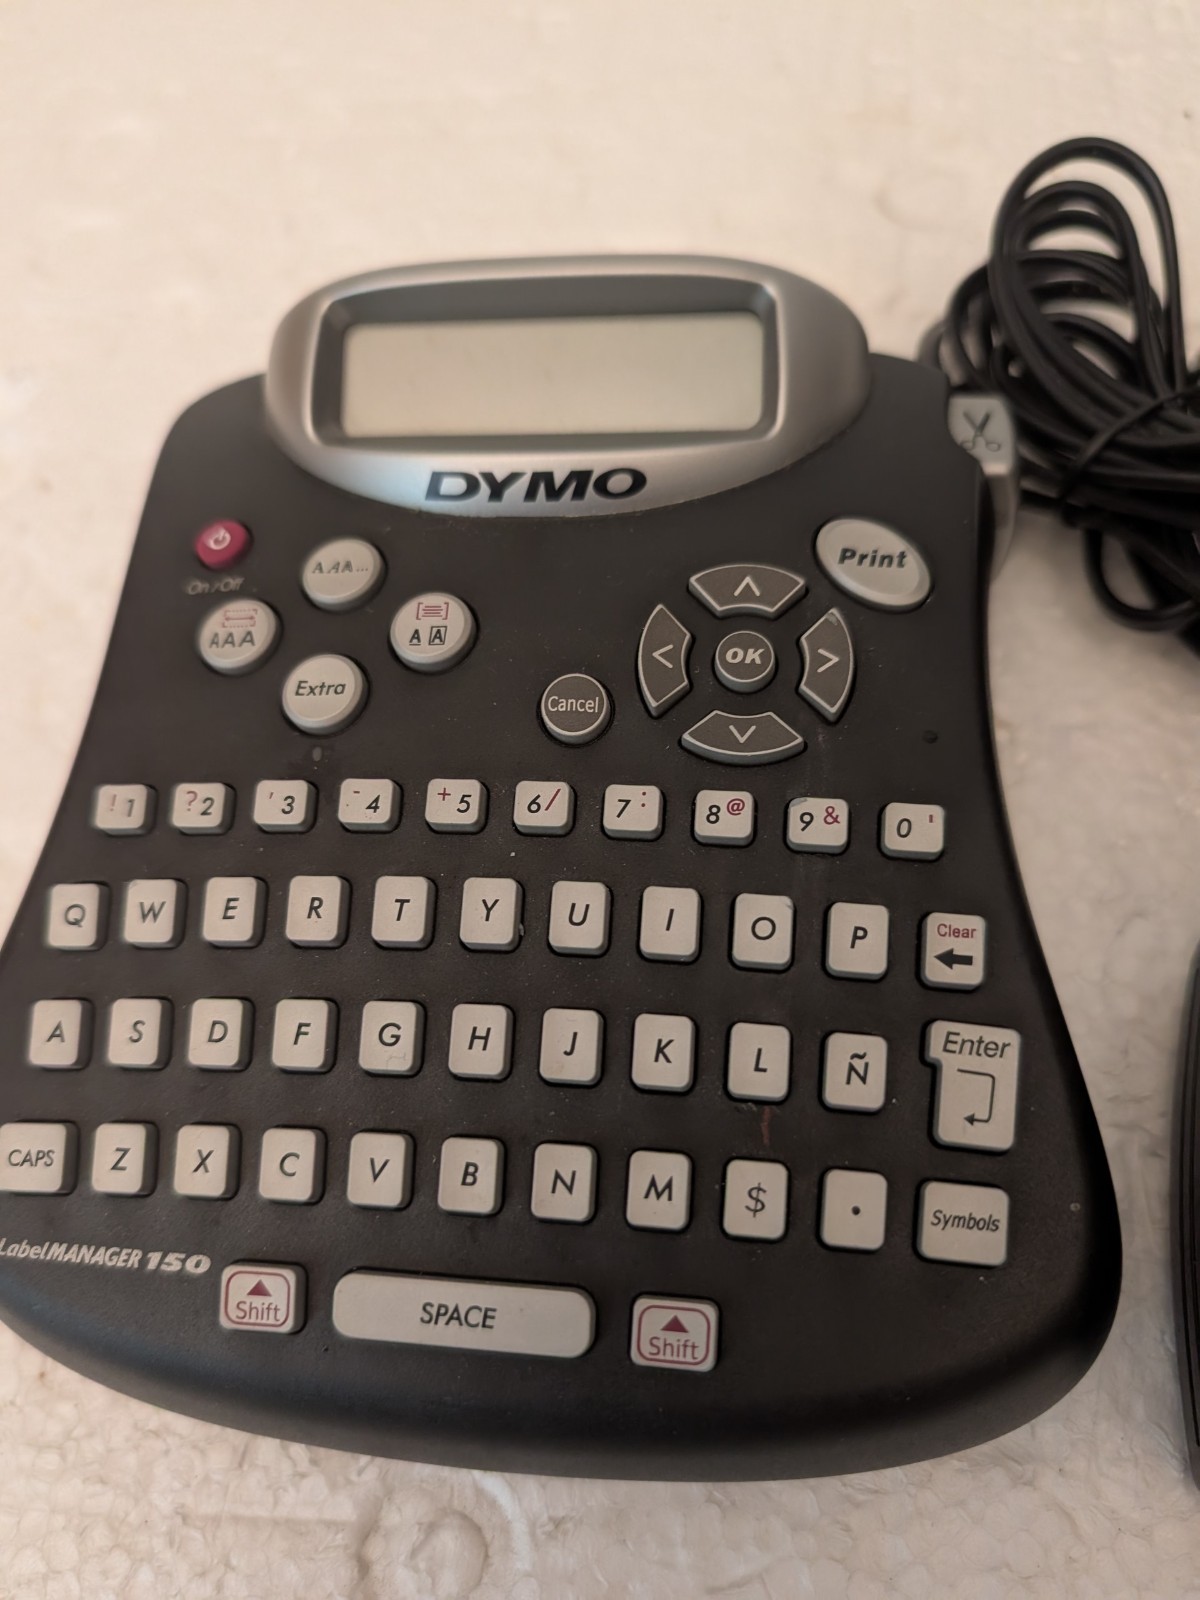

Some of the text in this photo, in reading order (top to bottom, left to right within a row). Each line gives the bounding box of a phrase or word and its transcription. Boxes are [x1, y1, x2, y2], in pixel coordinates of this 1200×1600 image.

[425, 468, 648, 503] DYMO
[838, 547, 907, 568] Print
[725, 647, 765, 665] OK
[294, 680, 347, 698] Extra
[547, 694, 599, 714] Cancel
[64, 903, 86, 928] Q
[139, 901, 166, 923] W
[222, 897, 240, 920] E
[306, 896, 323, 919] R
[393, 898, 410, 922] T
[481, 898, 499, 922] Y
[568, 902, 590, 926] U
[665, 908, 675, 931] I
[751, 916, 777, 941] O
[850, 925, 868, 949] P
[936, 922, 977, 940] Clear
[46, 1020, 66, 1043] A
[128, 1019, 146, 1043] S
[207, 1019, 228, 1043] D
[293, 1022, 311, 1045] F
[378, 1022, 401, 1047] G
[468, 1026, 491, 1051] H
[563, 1031, 578, 1057] J
[653, 1038, 675, 1064] K
[942, 1030, 1011, 1059] Enter
[753, 1047, 768, 1073] L
[845, 1050, 870, 1086] Ñ
[8, 1149, 55, 1168] CAPS
[110, 1147, 131, 1172] Z
[192, 1149, 214, 1174] X
[279, 1152, 300, 1177] C
[369, 1157, 390, 1183] V
[461, 1161, 479, 1187] B
[551, 1169, 576, 1195] N
[644, 1174, 674, 1202] M
[744, 1182, 767, 1218] $
[931, 1209, 1001, 1233] Symbols
[146, 1251, 212, 1275] 150
[235, 1301, 281, 1323] Shift
[419, 1302, 497, 1330] SPACE
[648, 1336, 700, 1361] Shift
